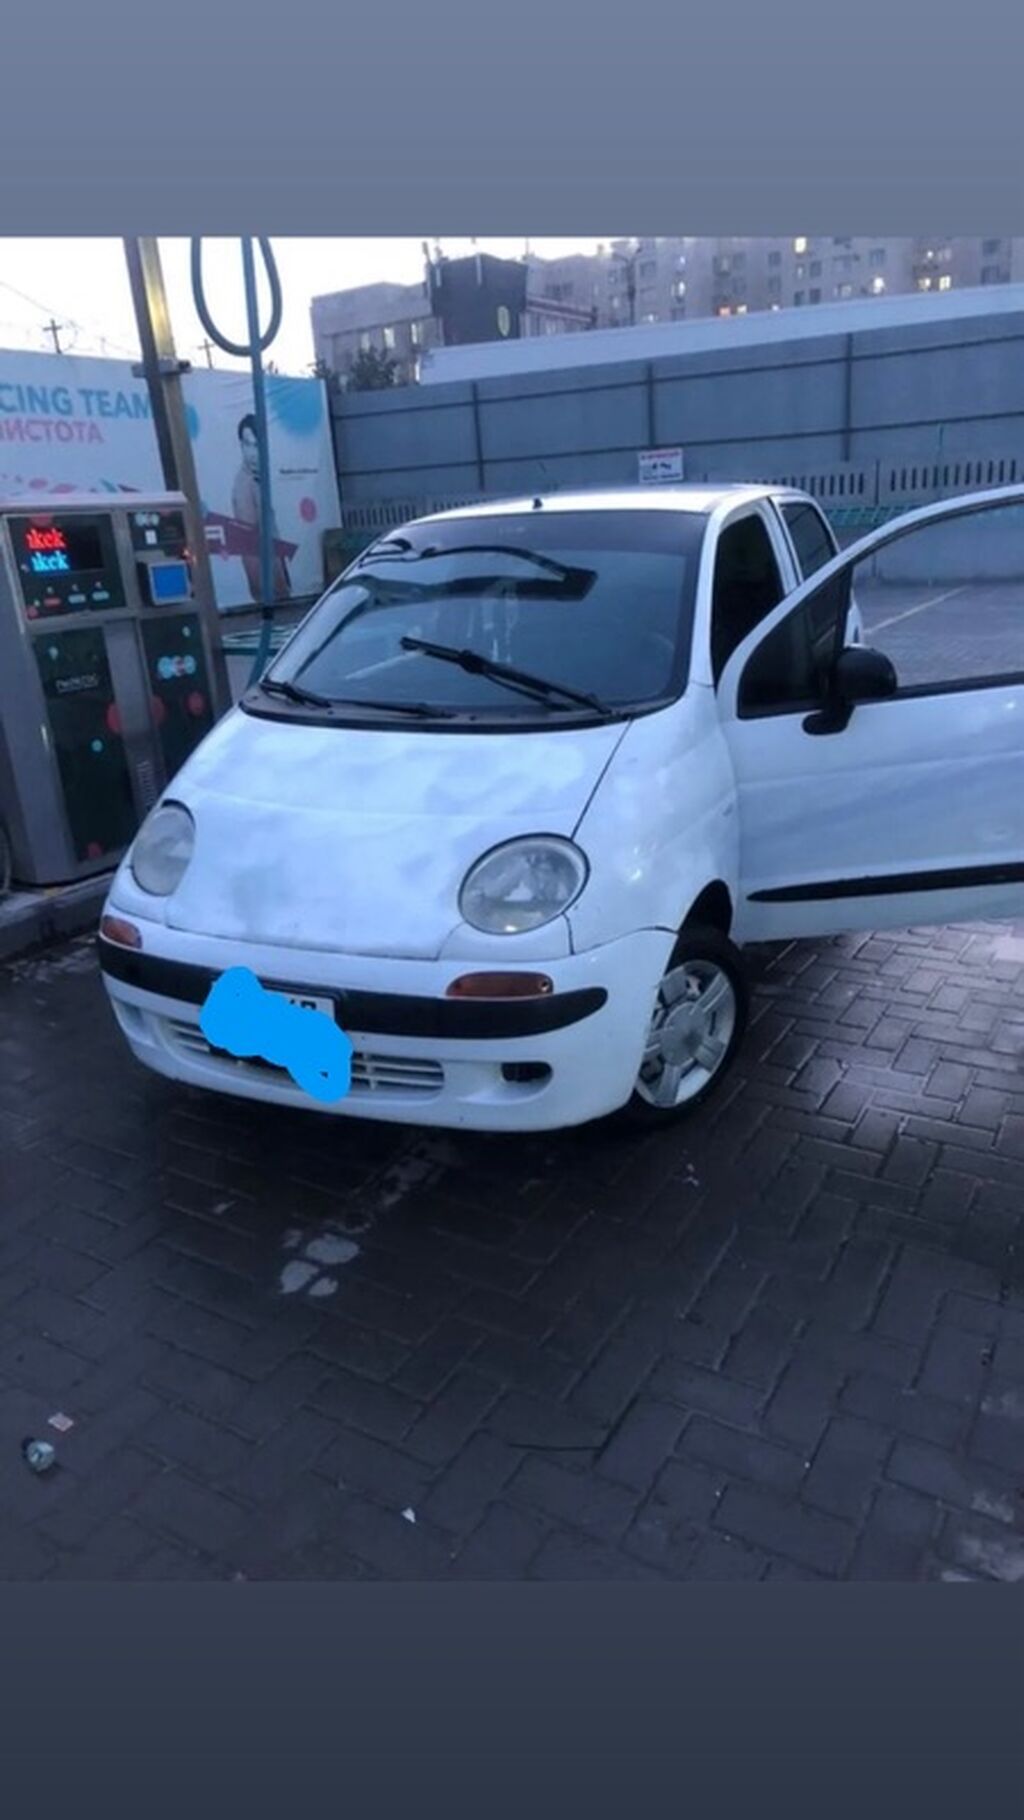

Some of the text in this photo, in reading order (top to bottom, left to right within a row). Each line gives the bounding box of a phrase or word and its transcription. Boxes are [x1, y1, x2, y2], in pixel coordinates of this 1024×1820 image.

[0, 383, 151, 419] CING TEAM
[0, 418, 104, 443] ИСТОТА
